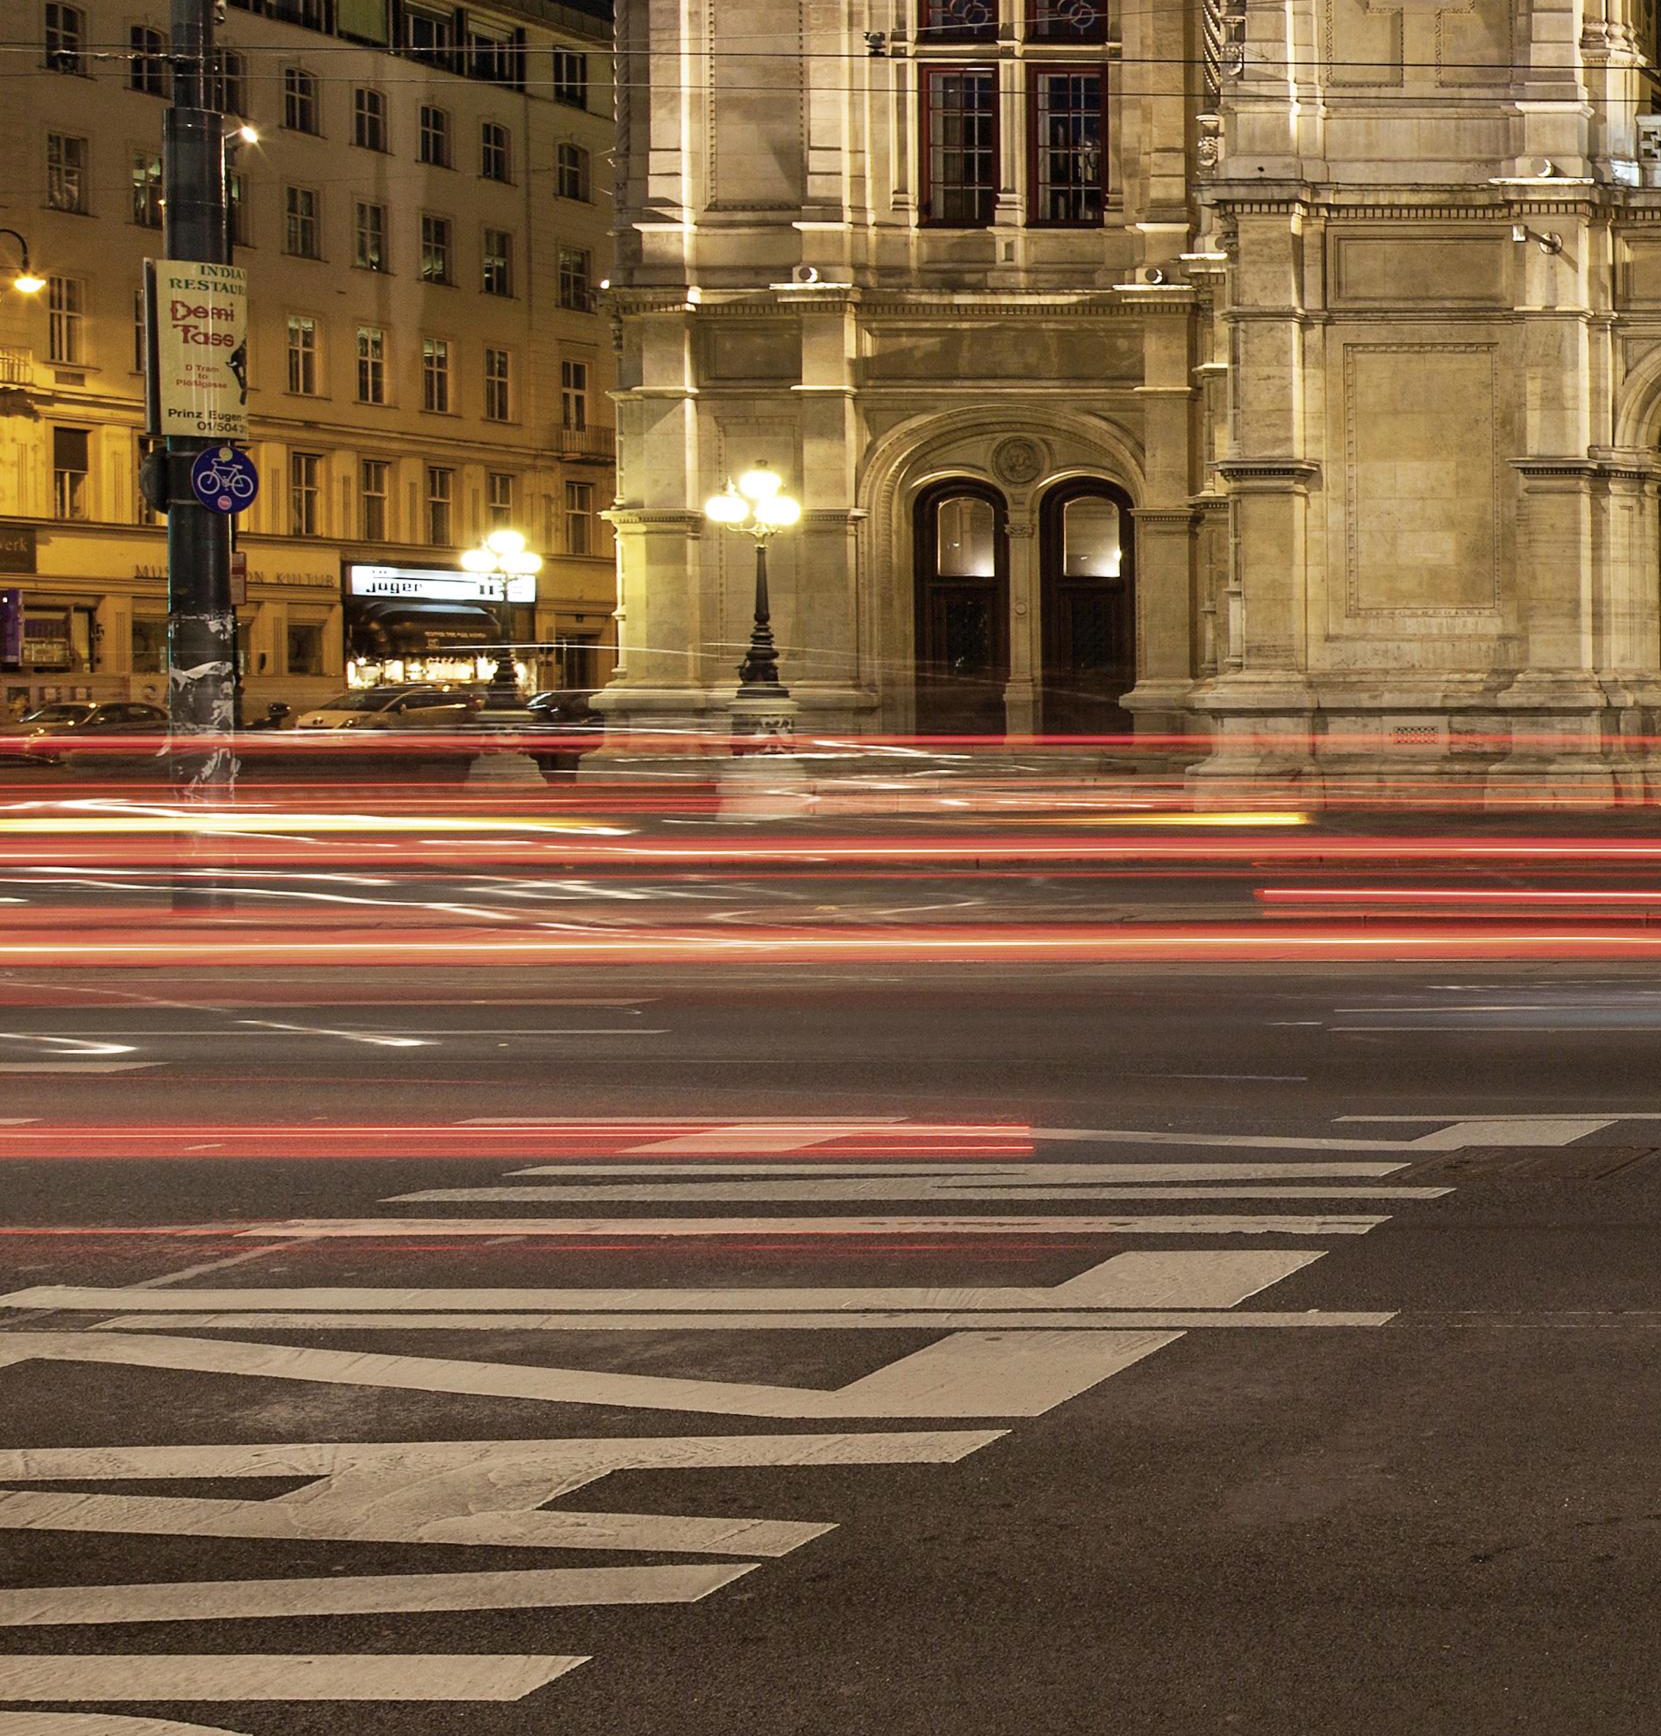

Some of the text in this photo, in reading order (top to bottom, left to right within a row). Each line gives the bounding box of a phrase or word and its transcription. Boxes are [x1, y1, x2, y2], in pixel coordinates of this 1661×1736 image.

[170, 300, 235, 322] Demi
[172, 324, 235, 347] Tass
[195, 365, 219, 373] Tram
[168, 408, 203, 419] Prinz
[276, 572, 336, 588] KULTUR
